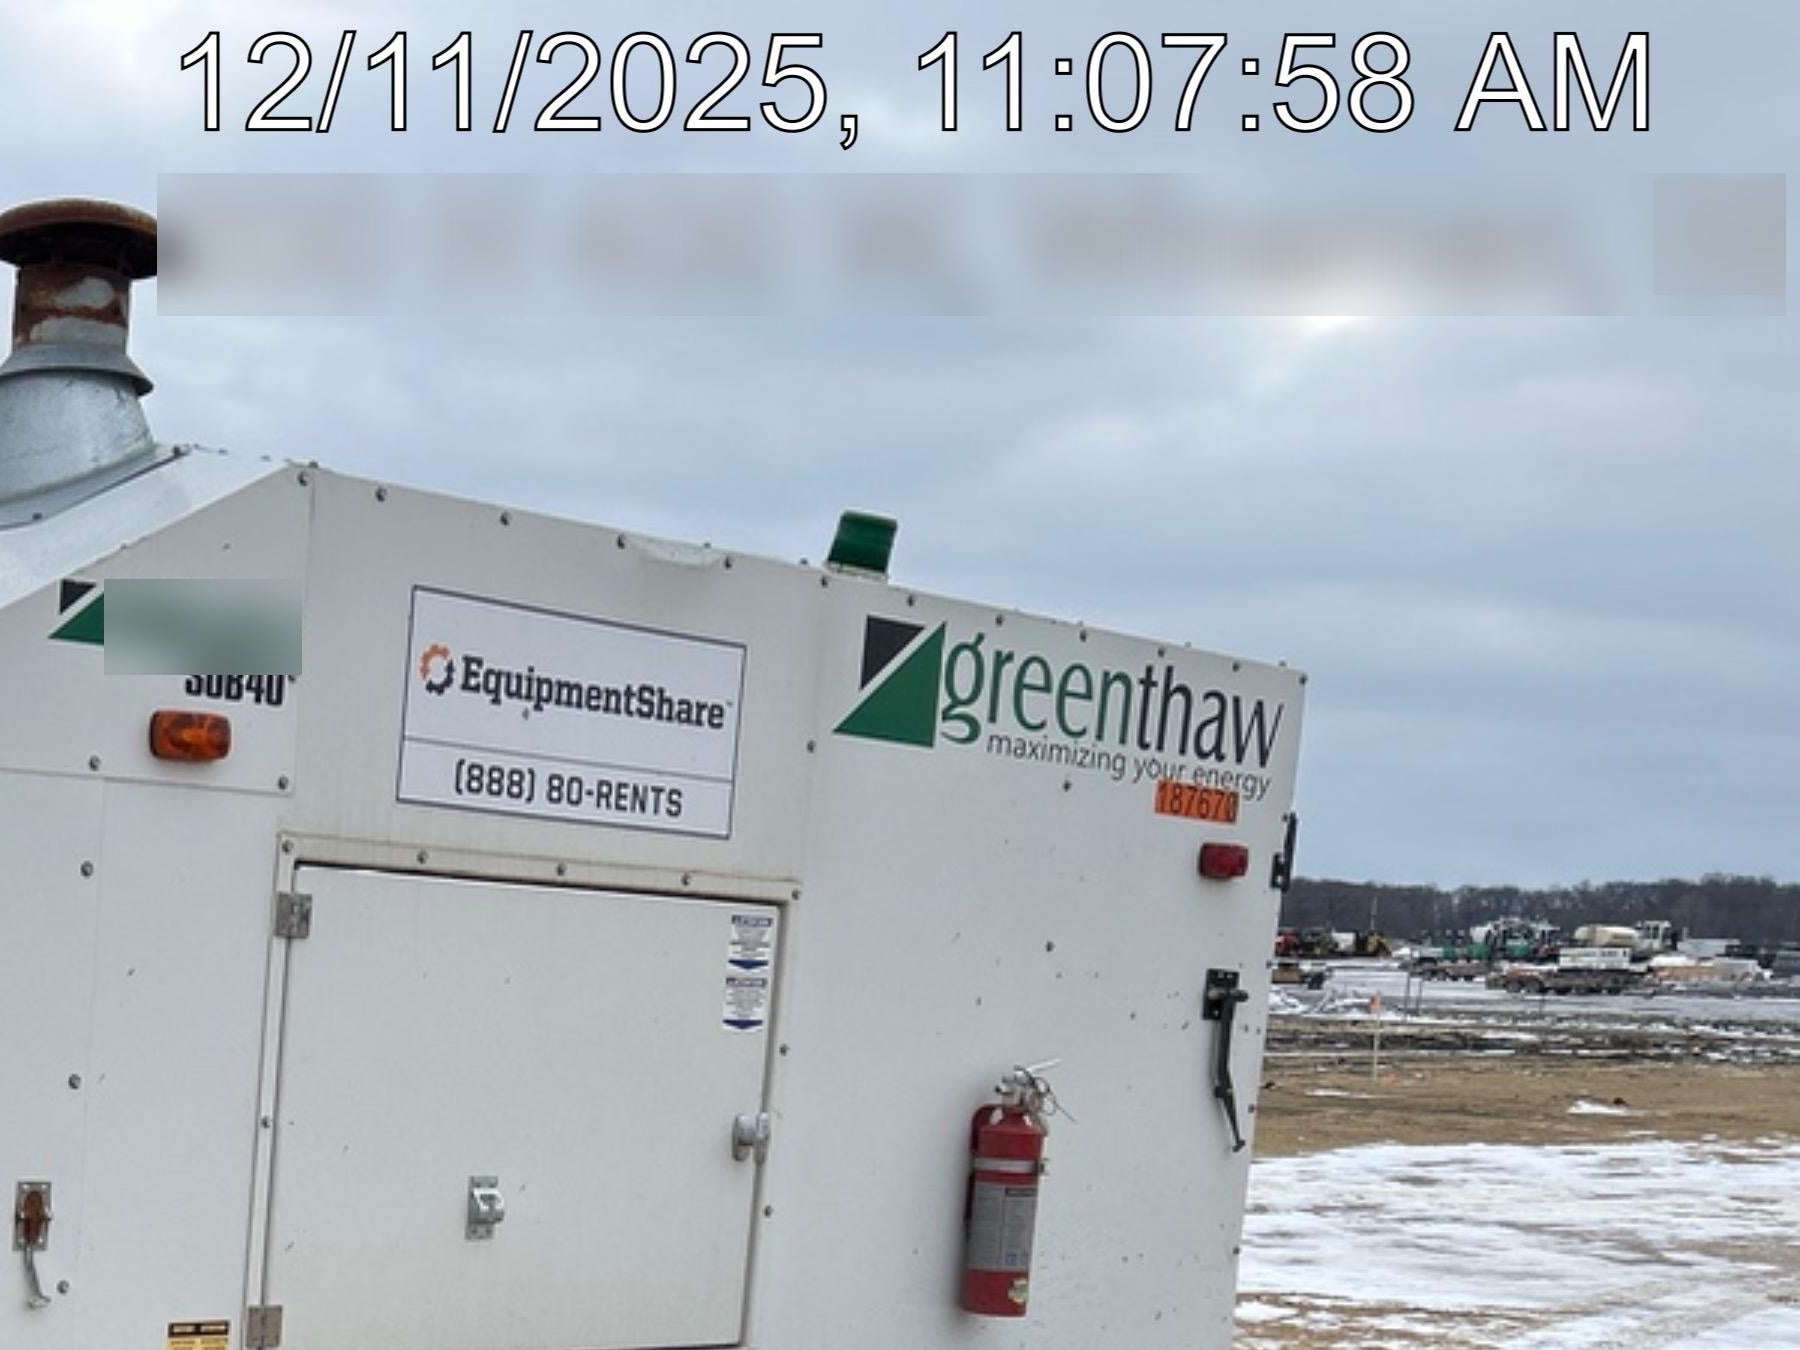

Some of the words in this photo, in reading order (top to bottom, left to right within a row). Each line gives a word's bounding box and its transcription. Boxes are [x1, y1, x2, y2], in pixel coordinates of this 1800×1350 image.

[459, 655, 725, 729] EquipmentShare
[941, 632, 1285, 769] greenthaw
[455, 758, 536, 803] (888)
[546, 772, 683, 818] 80-RENTS
[986, 730, 1127, 780] maximizing
[1132, 755, 1186, 784] your
[1193, 764, 1272, 801] energy
